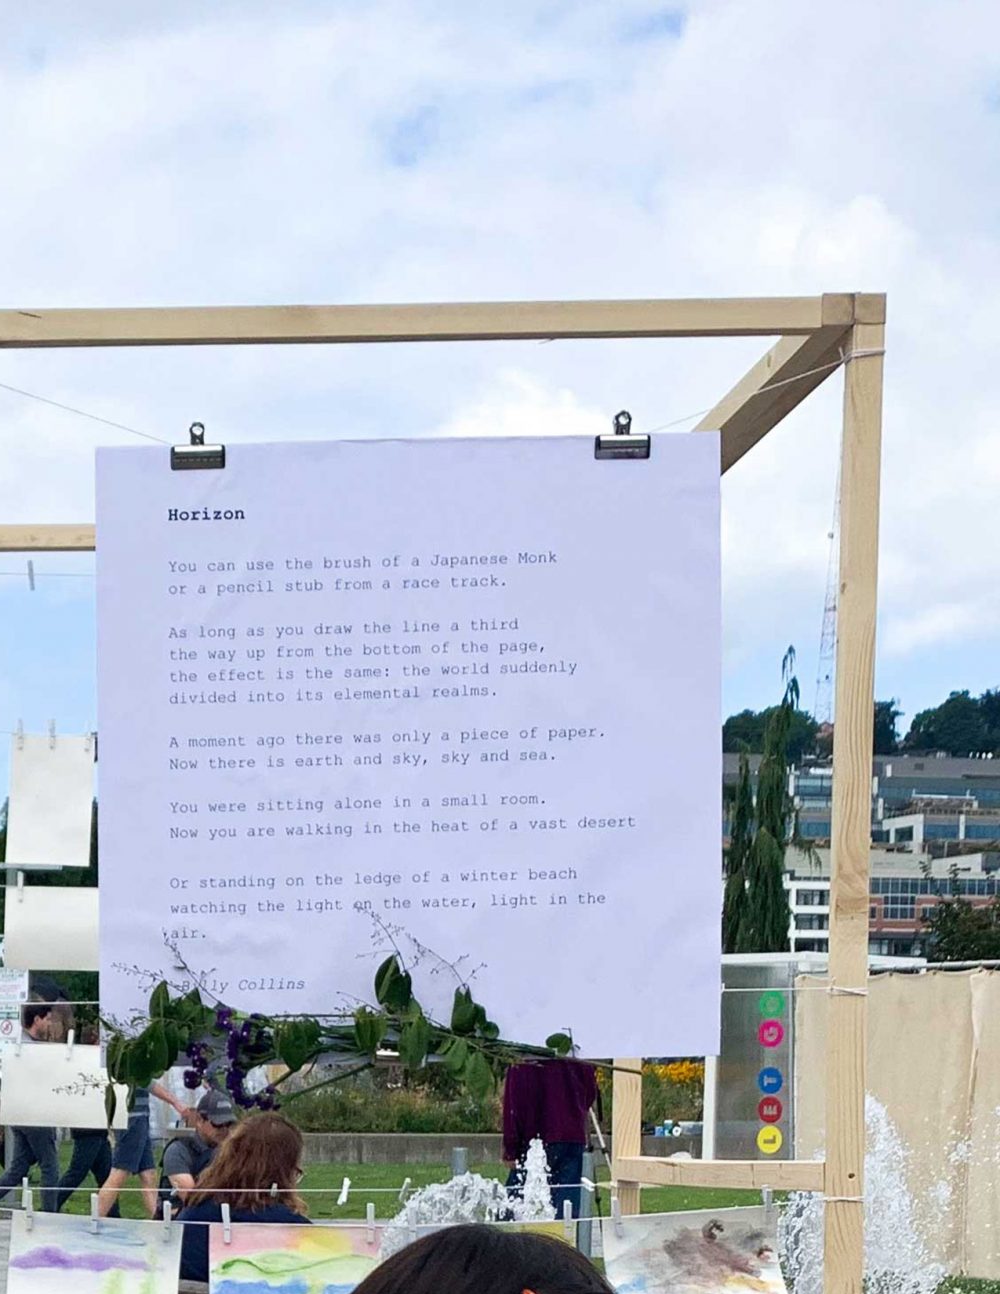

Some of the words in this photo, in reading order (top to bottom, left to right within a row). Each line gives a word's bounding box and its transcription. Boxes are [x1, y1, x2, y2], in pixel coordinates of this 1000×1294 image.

[167, 506, 246, 522] Horizon
[167, 560, 197, 573] You
[206, 561, 236, 572] can
[246, 560, 275, 571] use
[285, 557, 313, 570] the
[323, 555, 372, 570] brush
[381, 554, 401, 568] of
[410, 556, 420, 567] a
[430, 553, 509, 569] Japanese
[517, 550, 558, 565] Monk
[168, 584, 188, 596] or
[197, 584, 207, 595] a
[216, 579, 274, 597] pencil
[284, 578, 324, 593] stub
[334, 578, 373, 591] from
[381, 579, 391, 591] a
[402, 578, 441, 590] race
[450, 573, 506, 589] track.
[167, 626, 188, 639] As
[198, 625, 236, 641] long
[246, 626, 265, 637] as
[275, 626, 304, 640] you
[313, 622, 353, 636] draw
[363, 620, 392, 634] the
[402, 619, 441, 633] line
[449, 621, 460, 632] a
[470, 617, 519, 632] third
[169, 647, 198, 661] the
[207, 649, 237, 663] way
[246, 648, 266, 662] up
[276, 645, 314, 658] from
[324, 643, 353, 658] the
[362, 643, 422, 656] bottom
[430, 640, 450, 654] of
[460, 640, 489, 654] the
[498, 641, 545, 656] page,
[169, 669, 198, 683] the
[207, 668, 265, 682] effect
[276, 667, 294, 681] is
[305, 666, 334, 680] the
[343, 667, 390, 679] same:
[402, 663, 431, 677] the
[440, 661, 490, 676] world
[499, 659, 578, 676] suddenly
[168, 690, 237, 705] divided
[247, 690, 285, 703] into
[296, 688, 324, 702] its
[333, 685, 421, 701] elemental
[431, 684, 497, 699] realms.
[168, 736, 180, 749] A
[187, 735, 246, 748] moment
[255, 735, 285, 749] ago
[295, 732, 343, 746] there
[352, 733, 382, 744] was
[391, 729, 432, 745] only
[440, 731, 450, 742] a
[460, 727, 509, 744] piece
[519, 726, 539, 740] of
[548, 727, 605, 742] paper.
[168, 757, 199, 771] Now
[208, 756, 256, 770] there
[266, 754, 285, 768] is
[294, 753, 344, 768] earth
[353, 752, 383, 766] and
[392, 751, 428, 767] sky,
[440, 750, 471, 766] sky
[479, 748, 510, 763] and
[519, 751, 556, 762] sea.
[169, 801, 198, 814] You
[207, 802, 247, 813] were
[256, 797, 324, 814] sitting
[333, 796, 382, 810] alone
[393, 795, 412, 809] in
[421, 797, 431, 808] a
[440, 792, 489, 807] small
[500, 794, 546, 806] room.
[169, 826, 199, 839] Now
[208, 827, 237, 841] you
[246, 826, 276, 838] are
[285, 822, 353, 838] walking
[364, 821, 383, 834] in
[393, 820, 422, 834] the
[431, 819, 470, 833] heat
[479, 818, 499, 832] of
[508, 820, 518, 831] a
[528, 817, 568, 830] vast
[577, 815, 636, 830] desert
[169, 877, 189, 890] Or
[199, 874, 276, 891] standing
[285, 876, 305, 887] on
[315, 873, 343, 887] the
[354, 871, 402, 888] ledge
[411, 870, 431, 884] of
[439, 873, 451, 883] a
[459, 869, 519, 883] winter
[527, 866, 578, 881] beach
[170, 900, 247, 916] watching
[257, 899, 286, 913] the
[295, 898, 343, 914] light
[353, 899, 373, 911] on
[383, 896, 412, 910] the
[421, 897, 477, 910] water,
[490, 893, 538, 910] light
[549, 893, 568, 906] in
[577, 891, 606, 905] the
[170, 926, 207, 939] air.
[237, 977, 306, 991] Collins
